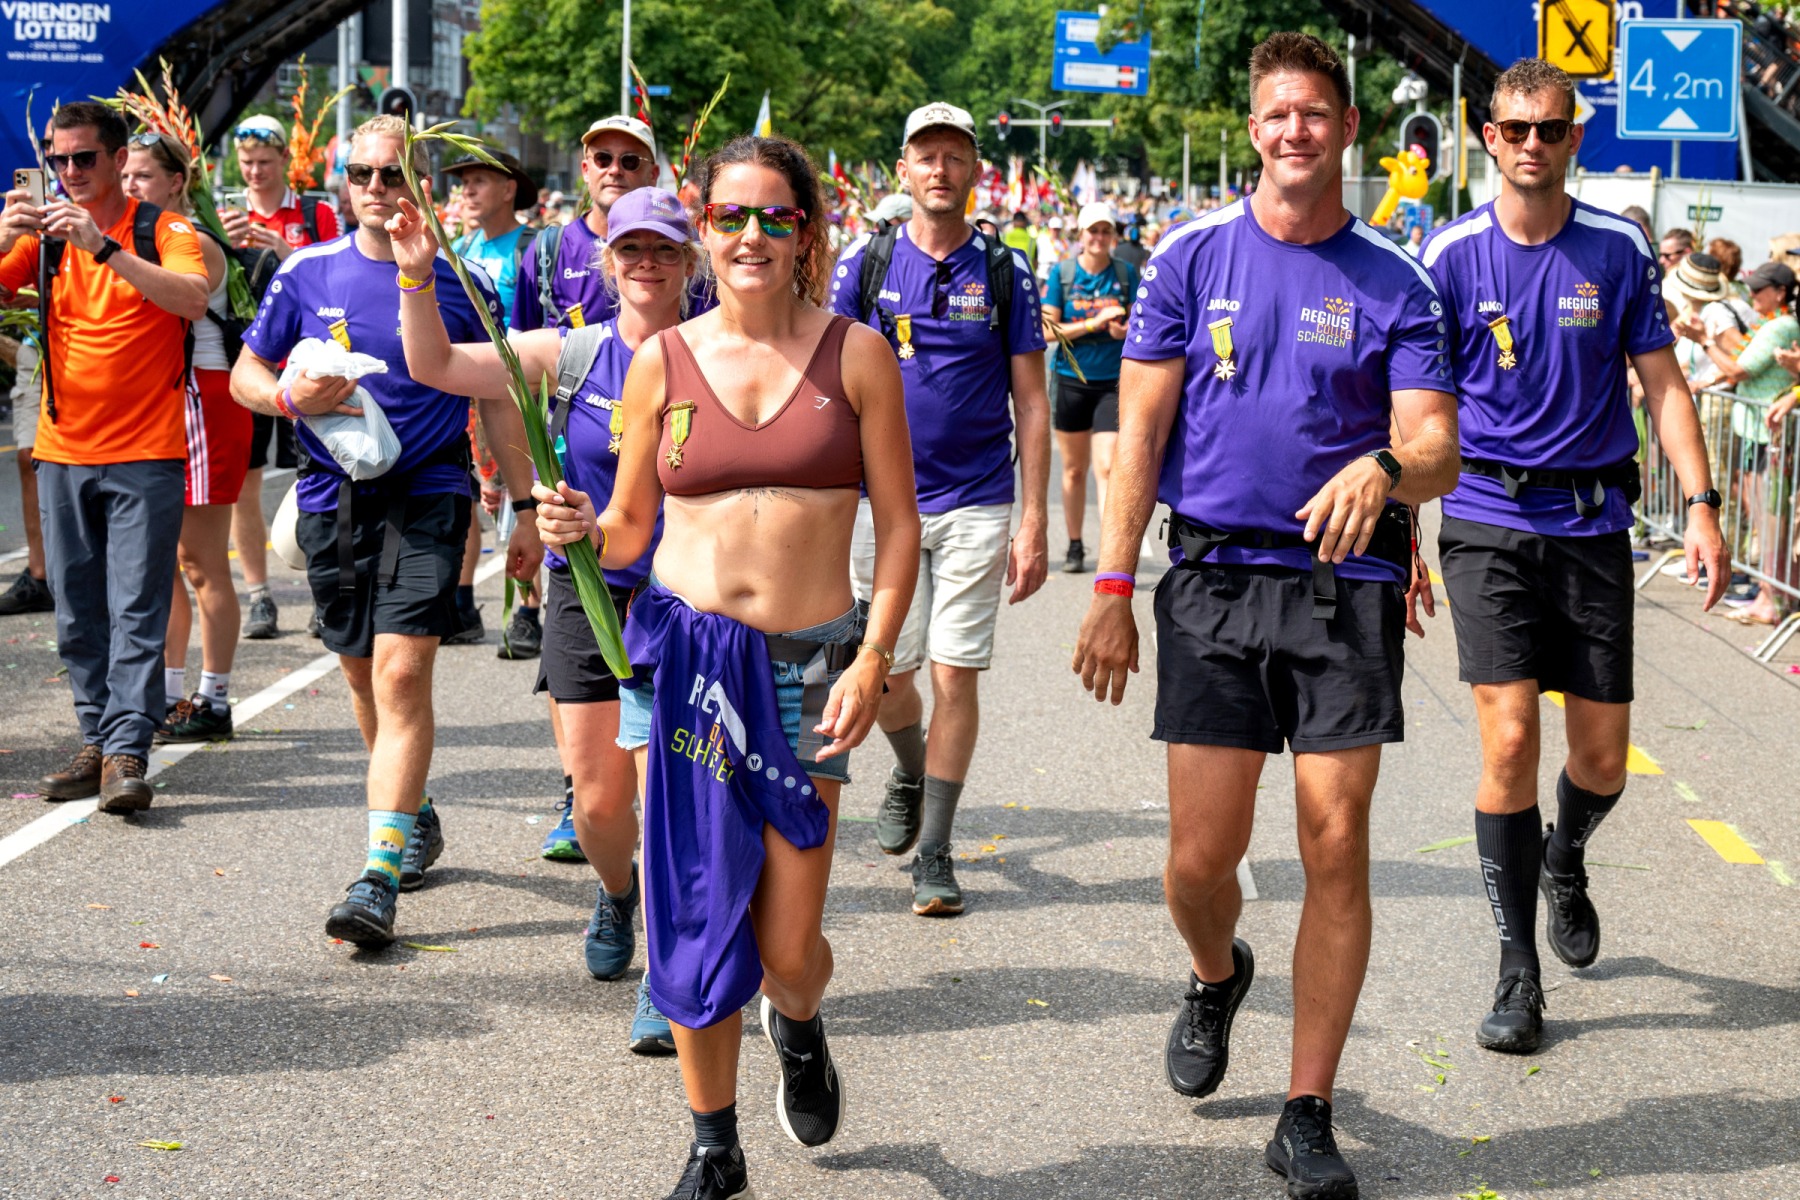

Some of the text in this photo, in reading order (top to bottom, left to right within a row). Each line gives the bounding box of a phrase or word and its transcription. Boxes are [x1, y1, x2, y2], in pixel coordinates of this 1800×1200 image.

[1, 2, 110, 22] VRIENDEN
[15, 21, 97, 42] LOTERIJ
[949, 295, 985, 307] REGIUS
[1207, 298, 1240, 312] JAKO
[1478, 301, 1503, 312] JAKO
[1558, 297, 1599, 310] REGIUS
[317, 306, 345, 318] JAKO
[949, 313, 985, 321] SCHAGEN
[1301, 307, 1350, 330] REGIUS
[1558, 317, 1597, 328] SCHAGEN
[1297, 330, 1346, 348] SCHAGEN
[1316, 323, 1356, 342] COLLEGE
